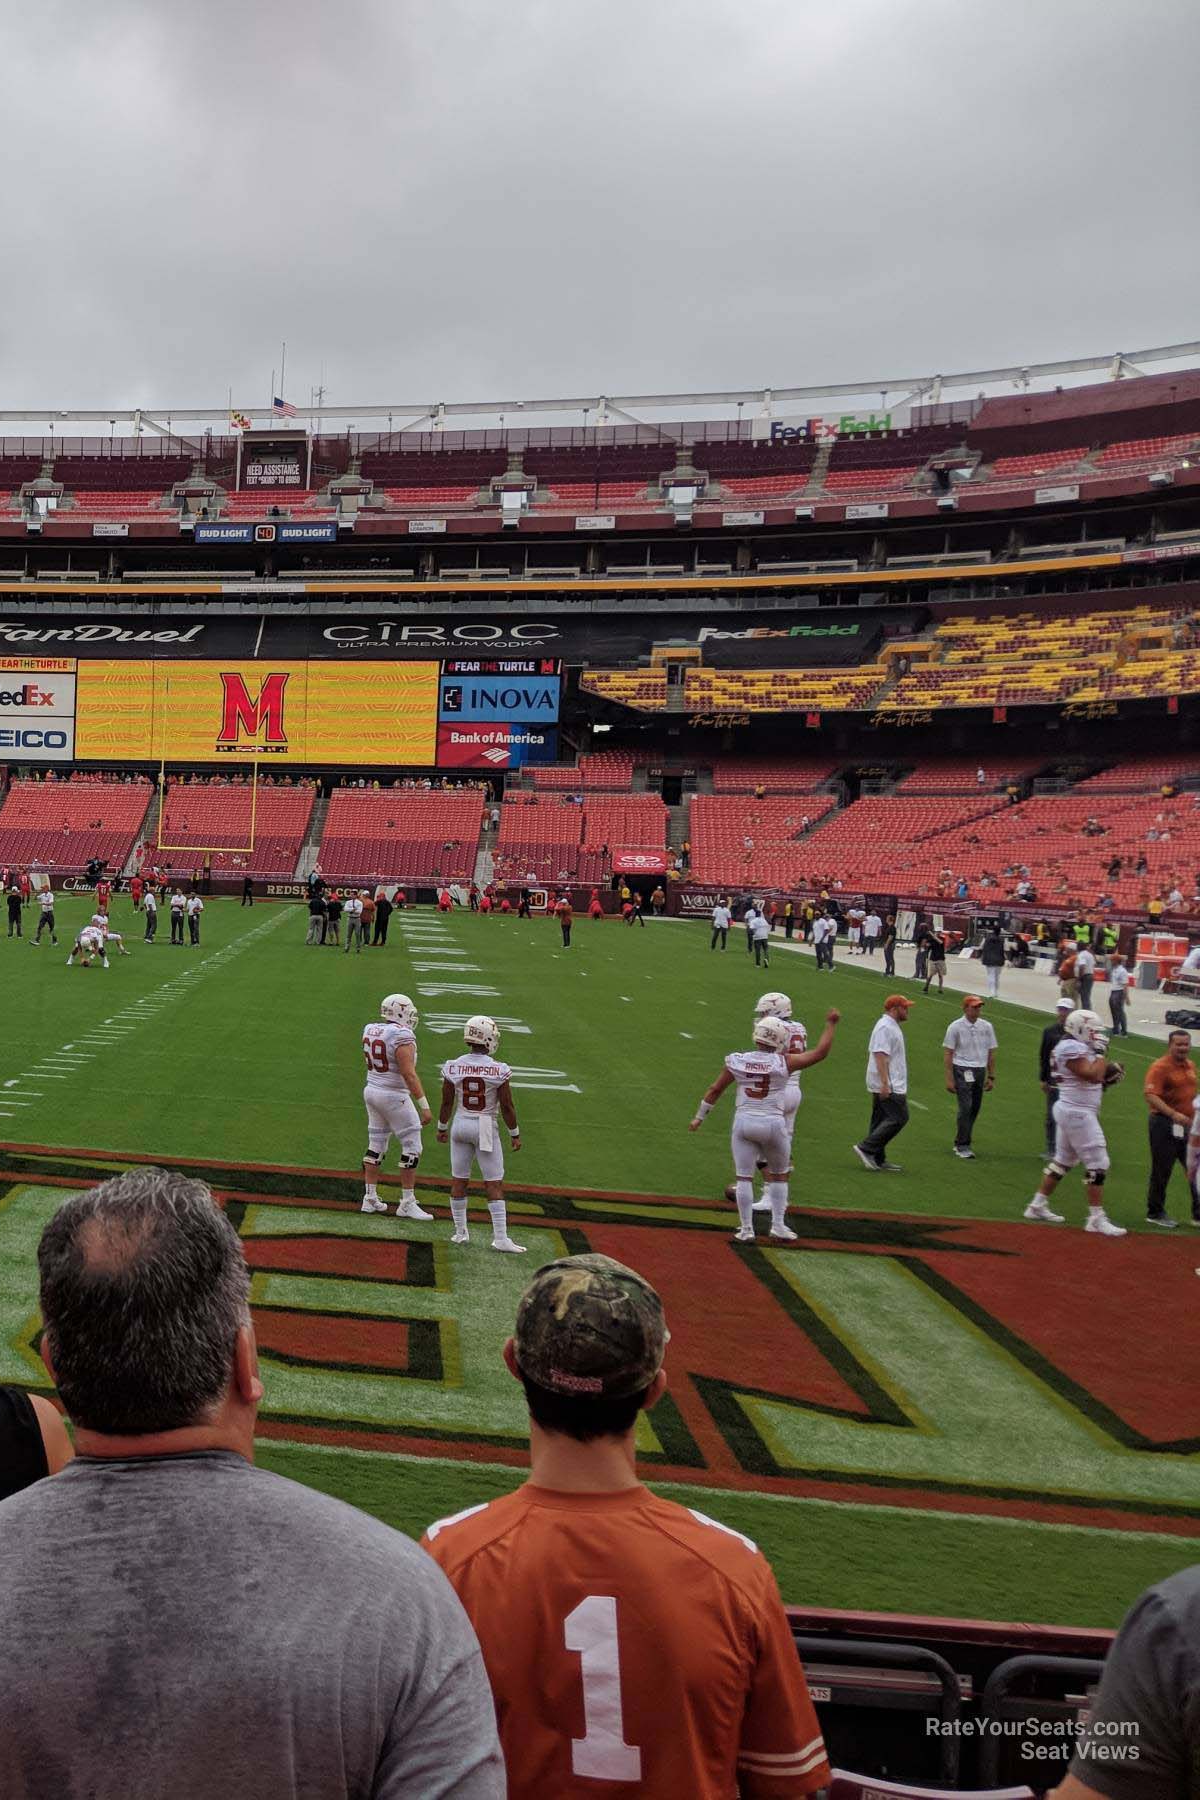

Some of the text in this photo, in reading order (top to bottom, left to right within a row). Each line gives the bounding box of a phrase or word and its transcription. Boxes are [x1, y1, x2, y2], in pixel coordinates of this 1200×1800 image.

[770, 414, 891, 440] FedExField
[246, 464, 300, 476] NEED ASSISTANCE
[246, 476, 258, 485] TEXT
[200, 529, 249, 538] BUD LIGHT
[258, 528, 272, 538] 40
[282, 528, 332, 537] BUD LIGHT
[323, 621, 561, 641] CÎROC
[697, 624, 860, 642] FedExField
[484, 640, 545, 648] VODKA
[448, 661, 535, 672] #FEARTHETURTLE
[471, 689, 554, 709] INOVA
[216, 673, 290, 742] M
[451, 732, 545, 744] Bank of America
[457, 1065, 501, 1077] THOMPSON
[744, 1073, 771, 1101] 3
[461, 1076, 487, 1112] 8
[564, 1595, 642, 1783] 1
